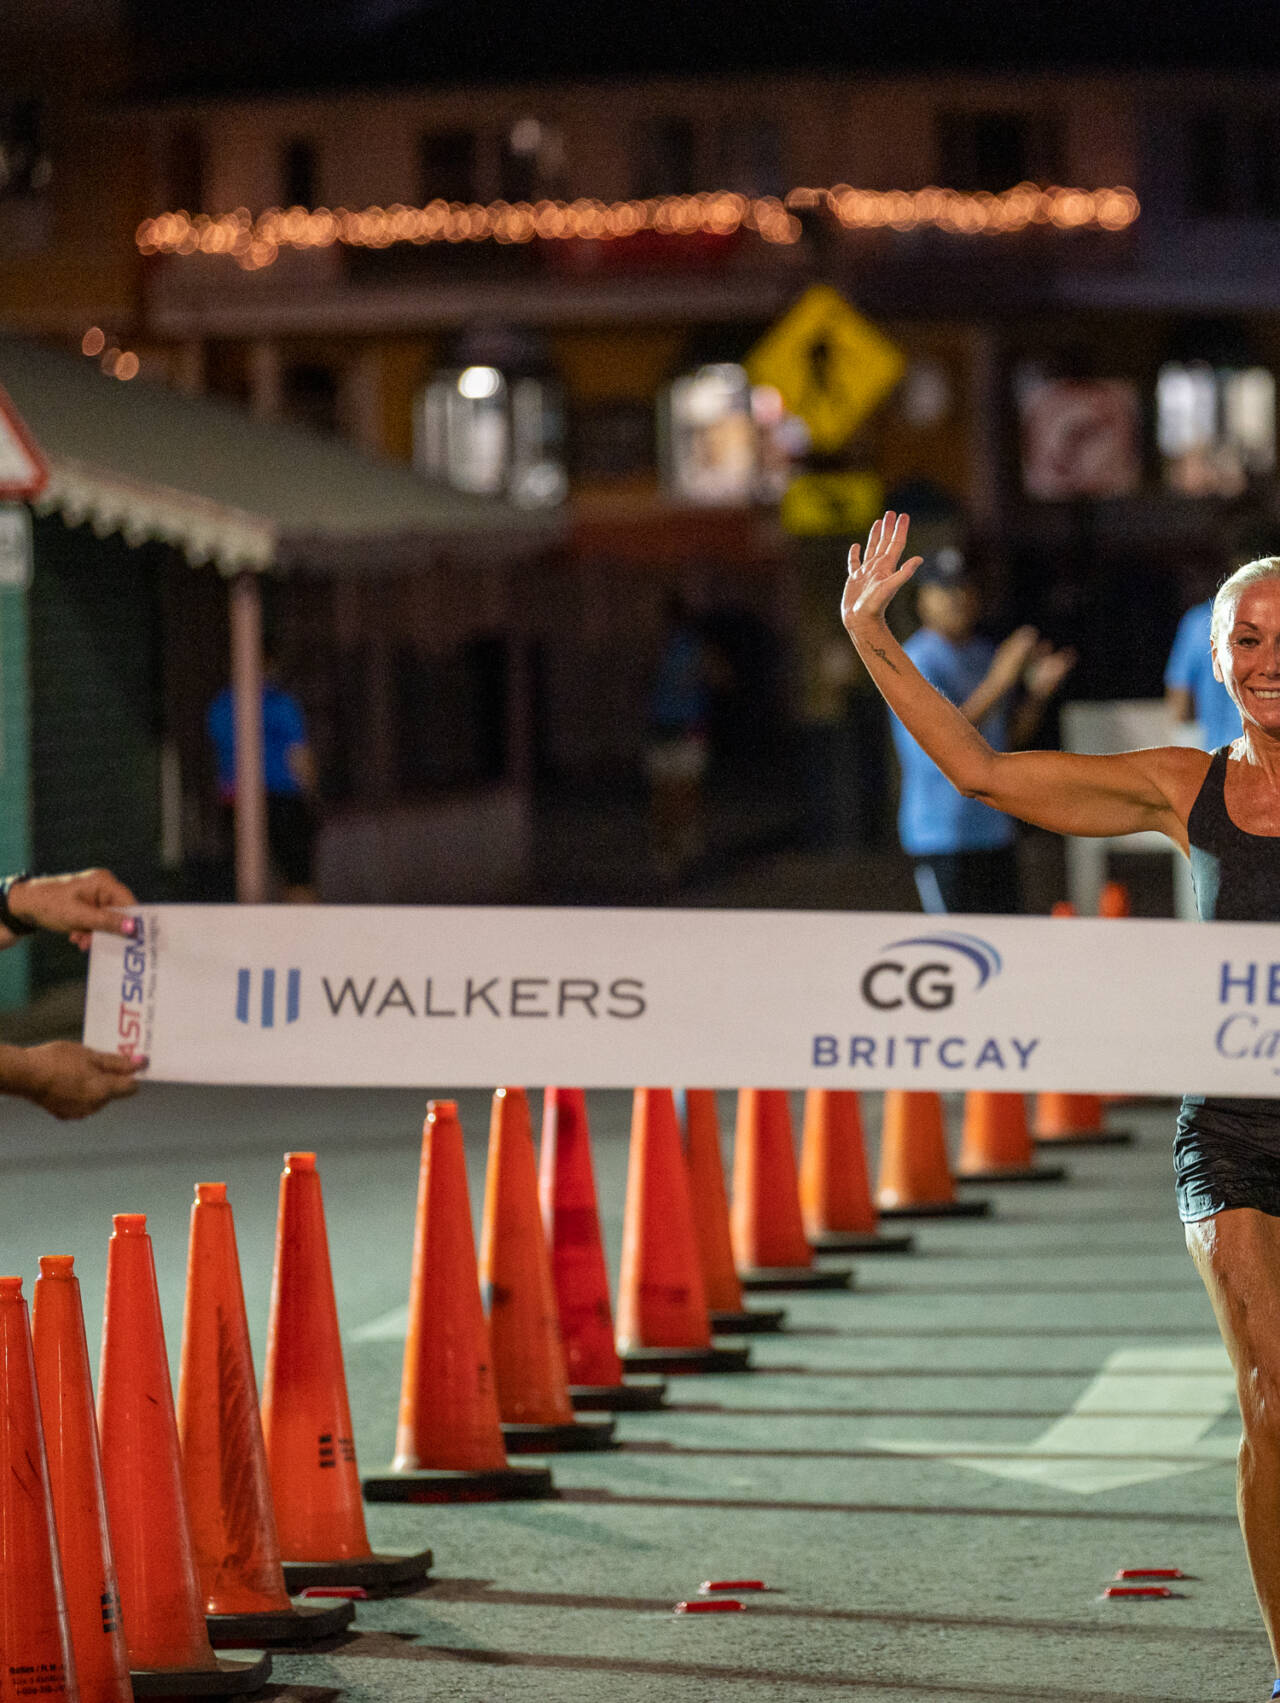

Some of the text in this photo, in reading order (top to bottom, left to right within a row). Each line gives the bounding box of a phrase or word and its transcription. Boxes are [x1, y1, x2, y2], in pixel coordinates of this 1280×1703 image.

[116, 914, 146, 1058] ASTSIGN
[322, 977, 648, 1020] WALKERS
[860, 960, 956, 1012] CG
[812, 1035, 1040, 1071] BRITCAY
